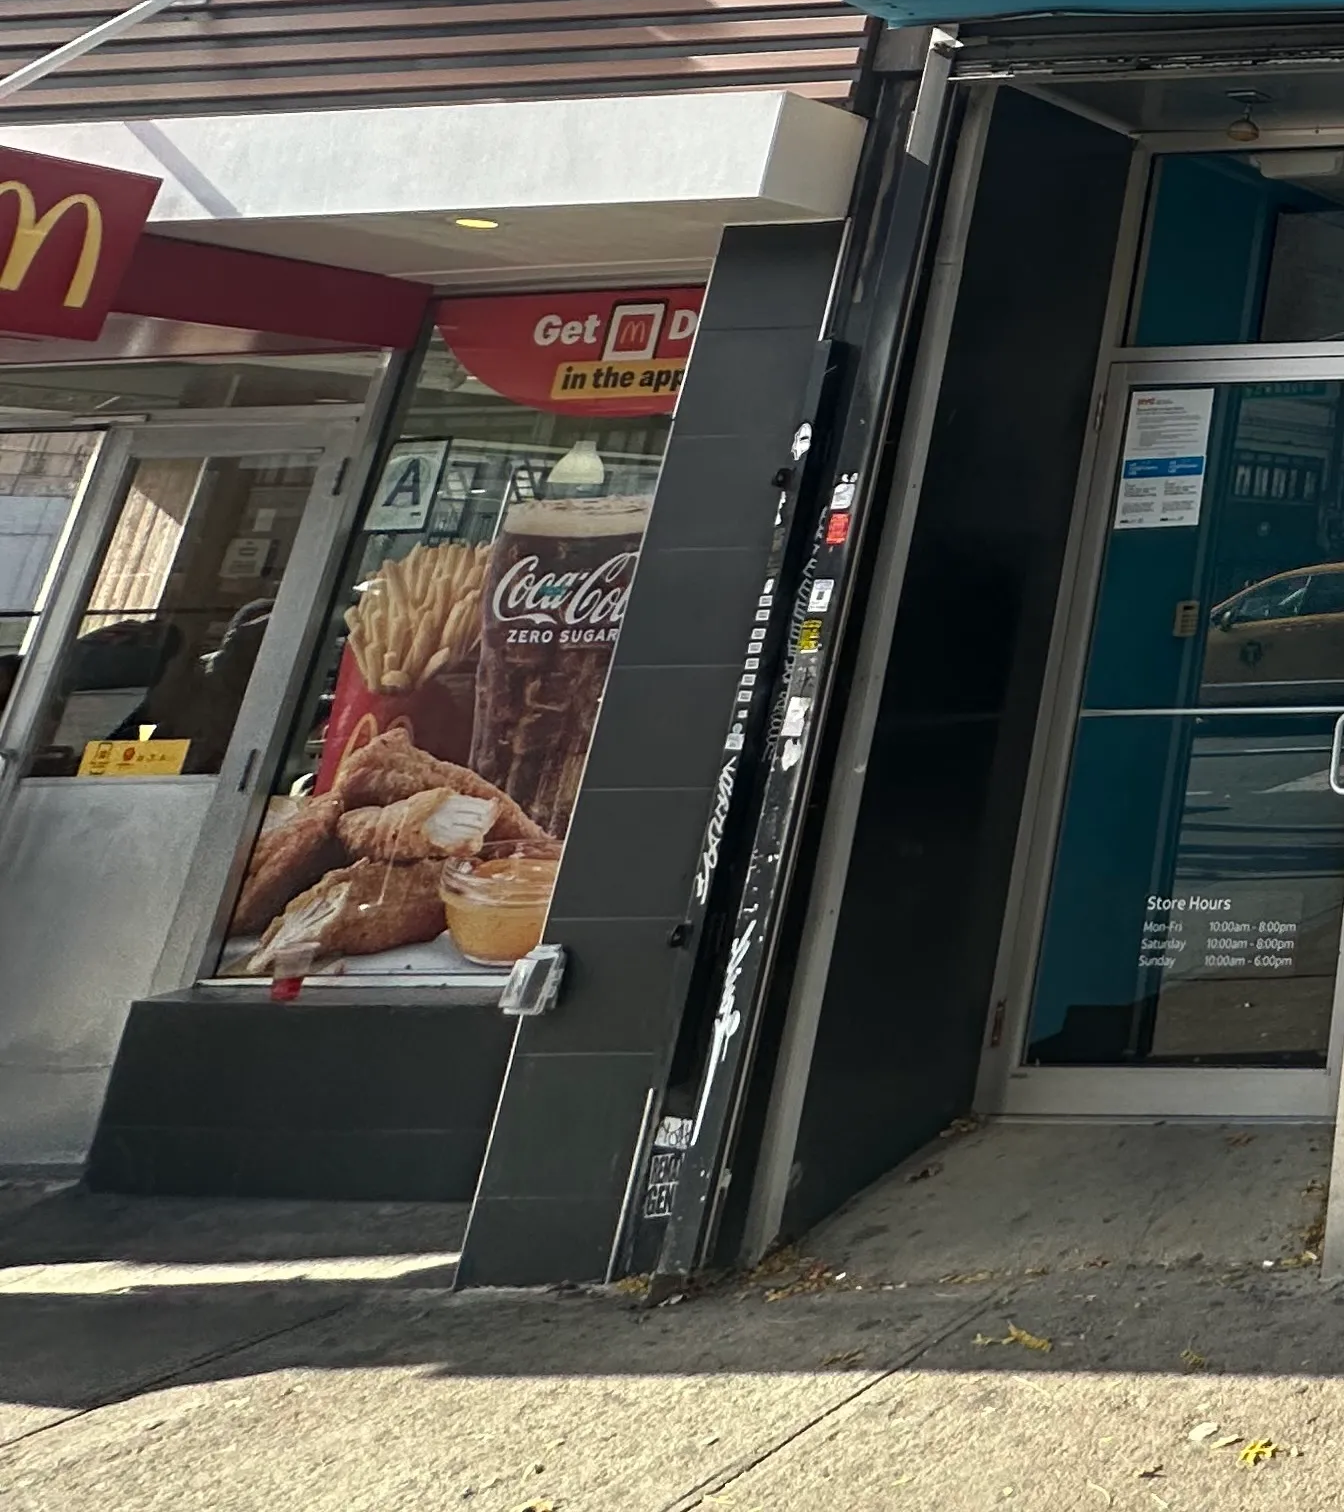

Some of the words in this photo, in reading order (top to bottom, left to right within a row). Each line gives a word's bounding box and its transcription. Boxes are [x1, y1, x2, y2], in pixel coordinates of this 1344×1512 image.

[533, 314, 601, 346] Get
[561, 366, 585, 390] in
[592, 366, 635, 388] the
[639, 369, 685, 393] app
[507, 629, 553, 644] ZERO
[559, 628, 621, 644] SUGAR
[1147, 896, 1186, 911] Store
[1188, 896, 1231, 910] Hours
[1143, 920, 1183, 932] Mon-Fri
[1209, 921, 1250, 932] 10:00am
[1141, 938, 1186, 952] Saturday
[1206, 938, 1247, 949] 10:00am
[1138, 955, 1176, 968] Sunday
[1204, 955, 1245, 966] 10:00am
